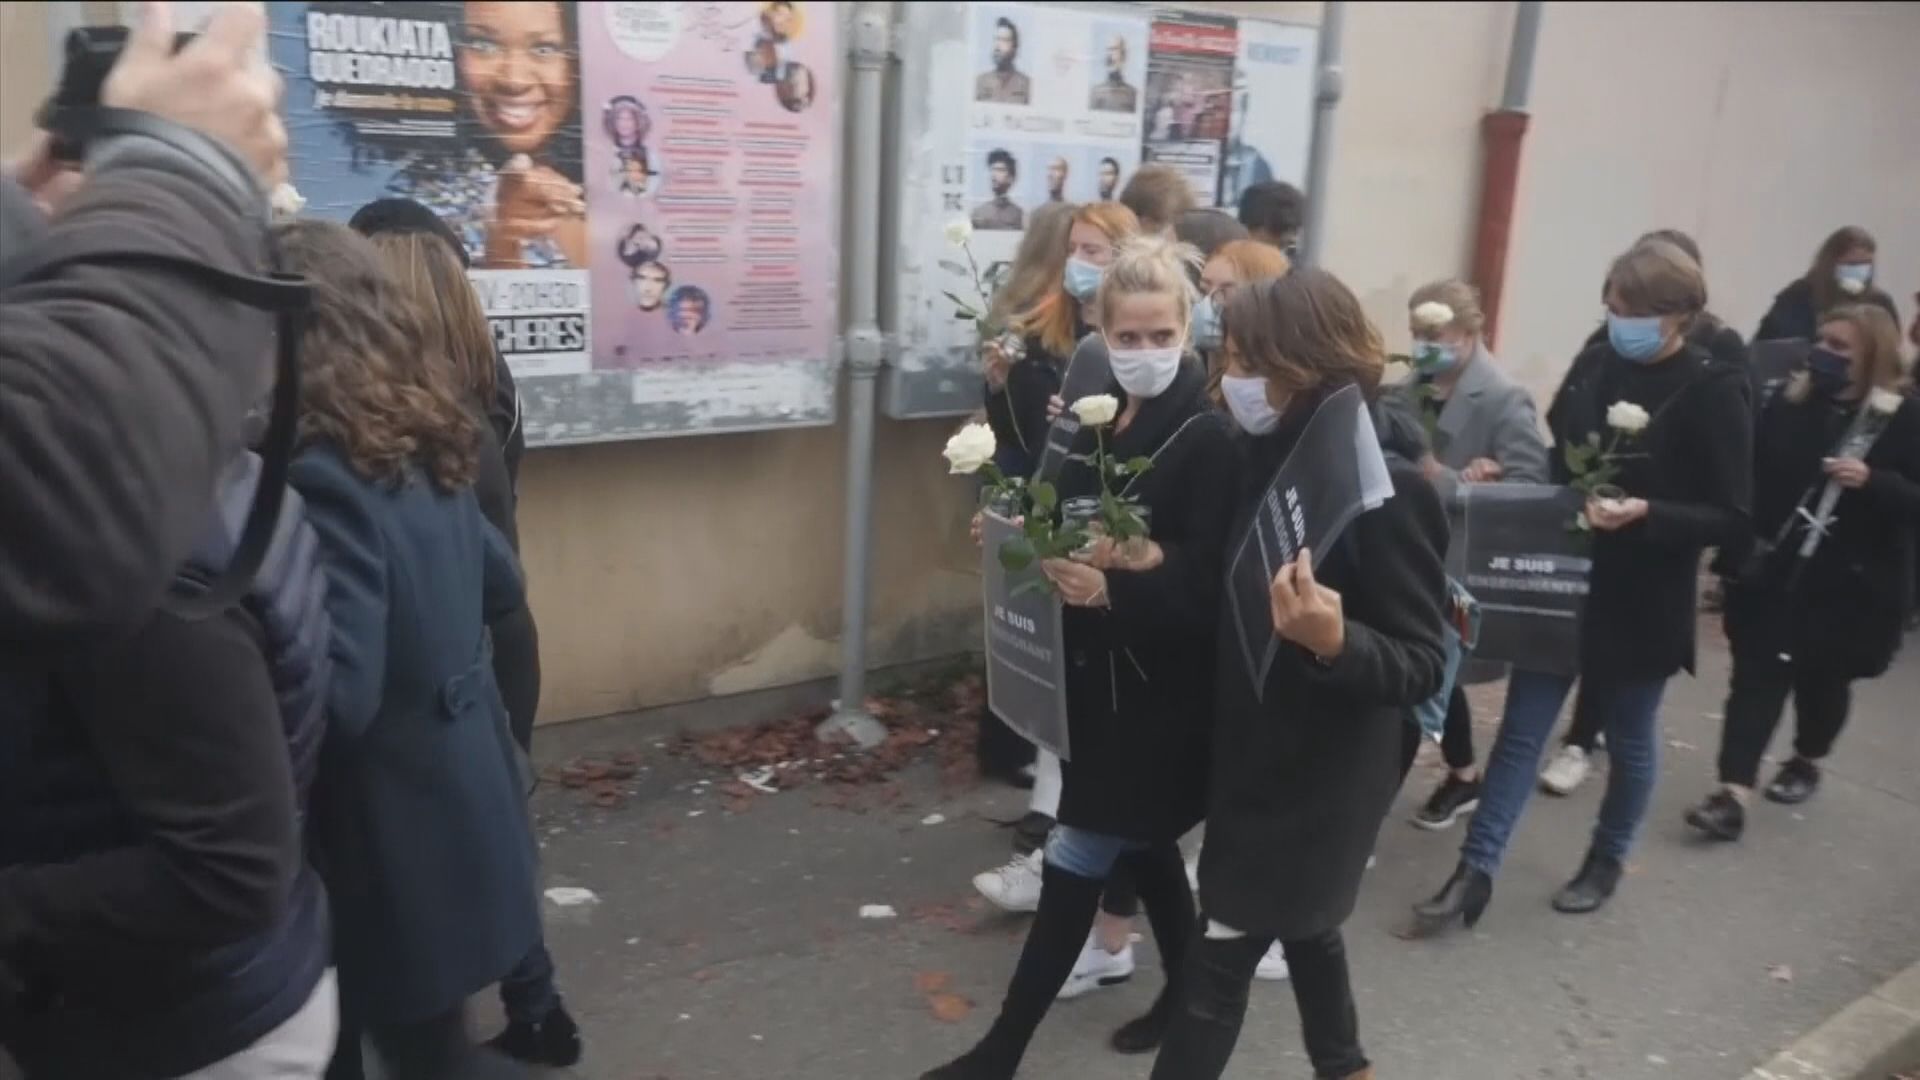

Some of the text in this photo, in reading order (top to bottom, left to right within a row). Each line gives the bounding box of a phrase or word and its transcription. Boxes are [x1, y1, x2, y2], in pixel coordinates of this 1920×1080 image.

[308, 12, 453, 58] ROUKIATA
[1488, 557, 1556, 573] JE SUIS
[994, 605, 1036, 635] JE SUIS
